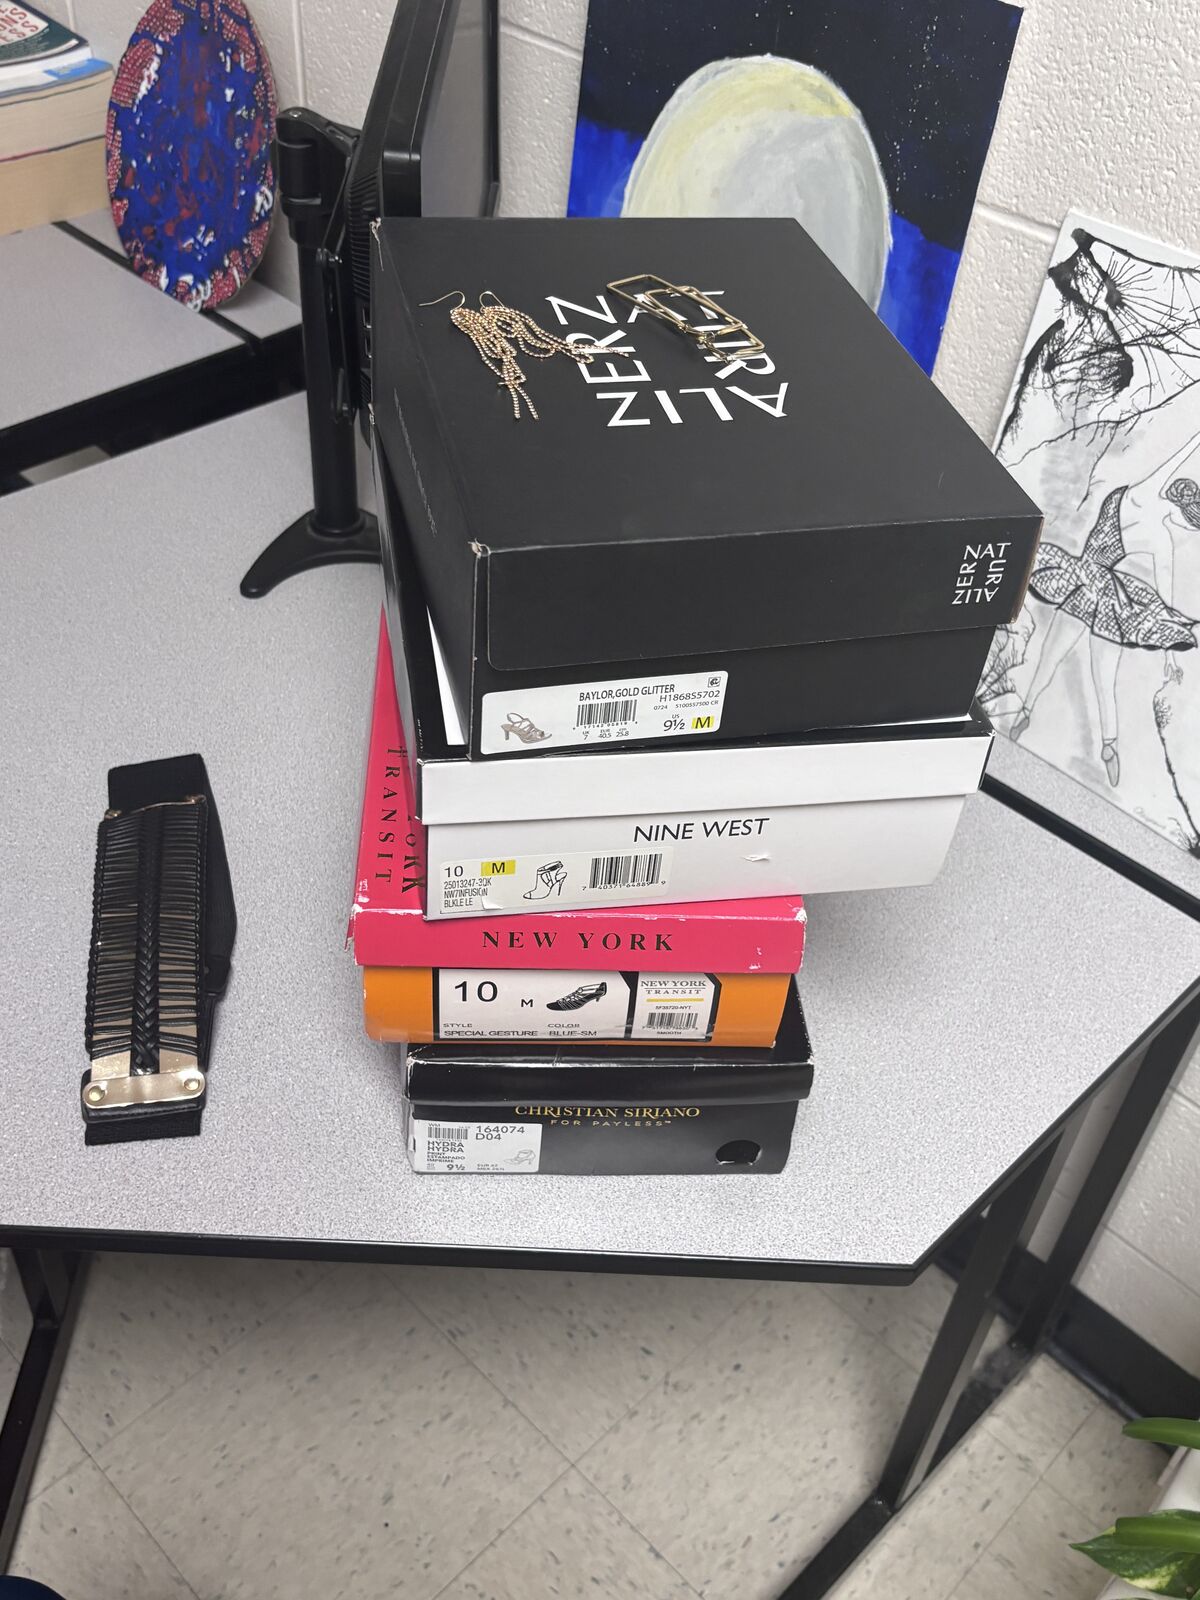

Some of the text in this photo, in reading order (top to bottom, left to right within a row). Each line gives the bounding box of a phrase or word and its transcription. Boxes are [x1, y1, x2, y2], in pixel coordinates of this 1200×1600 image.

[640, 683, 675, 696] GLITTER
[695, 715, 711, 729] M
[374, 747, 404, 884] TRANSIT
[633, 818, 770, 842] NINE WEST
[444, 861, 506, 878] 10 M
[465, 898, 474, 906] LE
[482, 931, 673, 951] NEW YORK
[454, 981, 534, 1008] 10 M
[515, 1104, 701, 1119] CHRISTIAN SIRIANO
[476, 1125, 525, 1134] 164074
